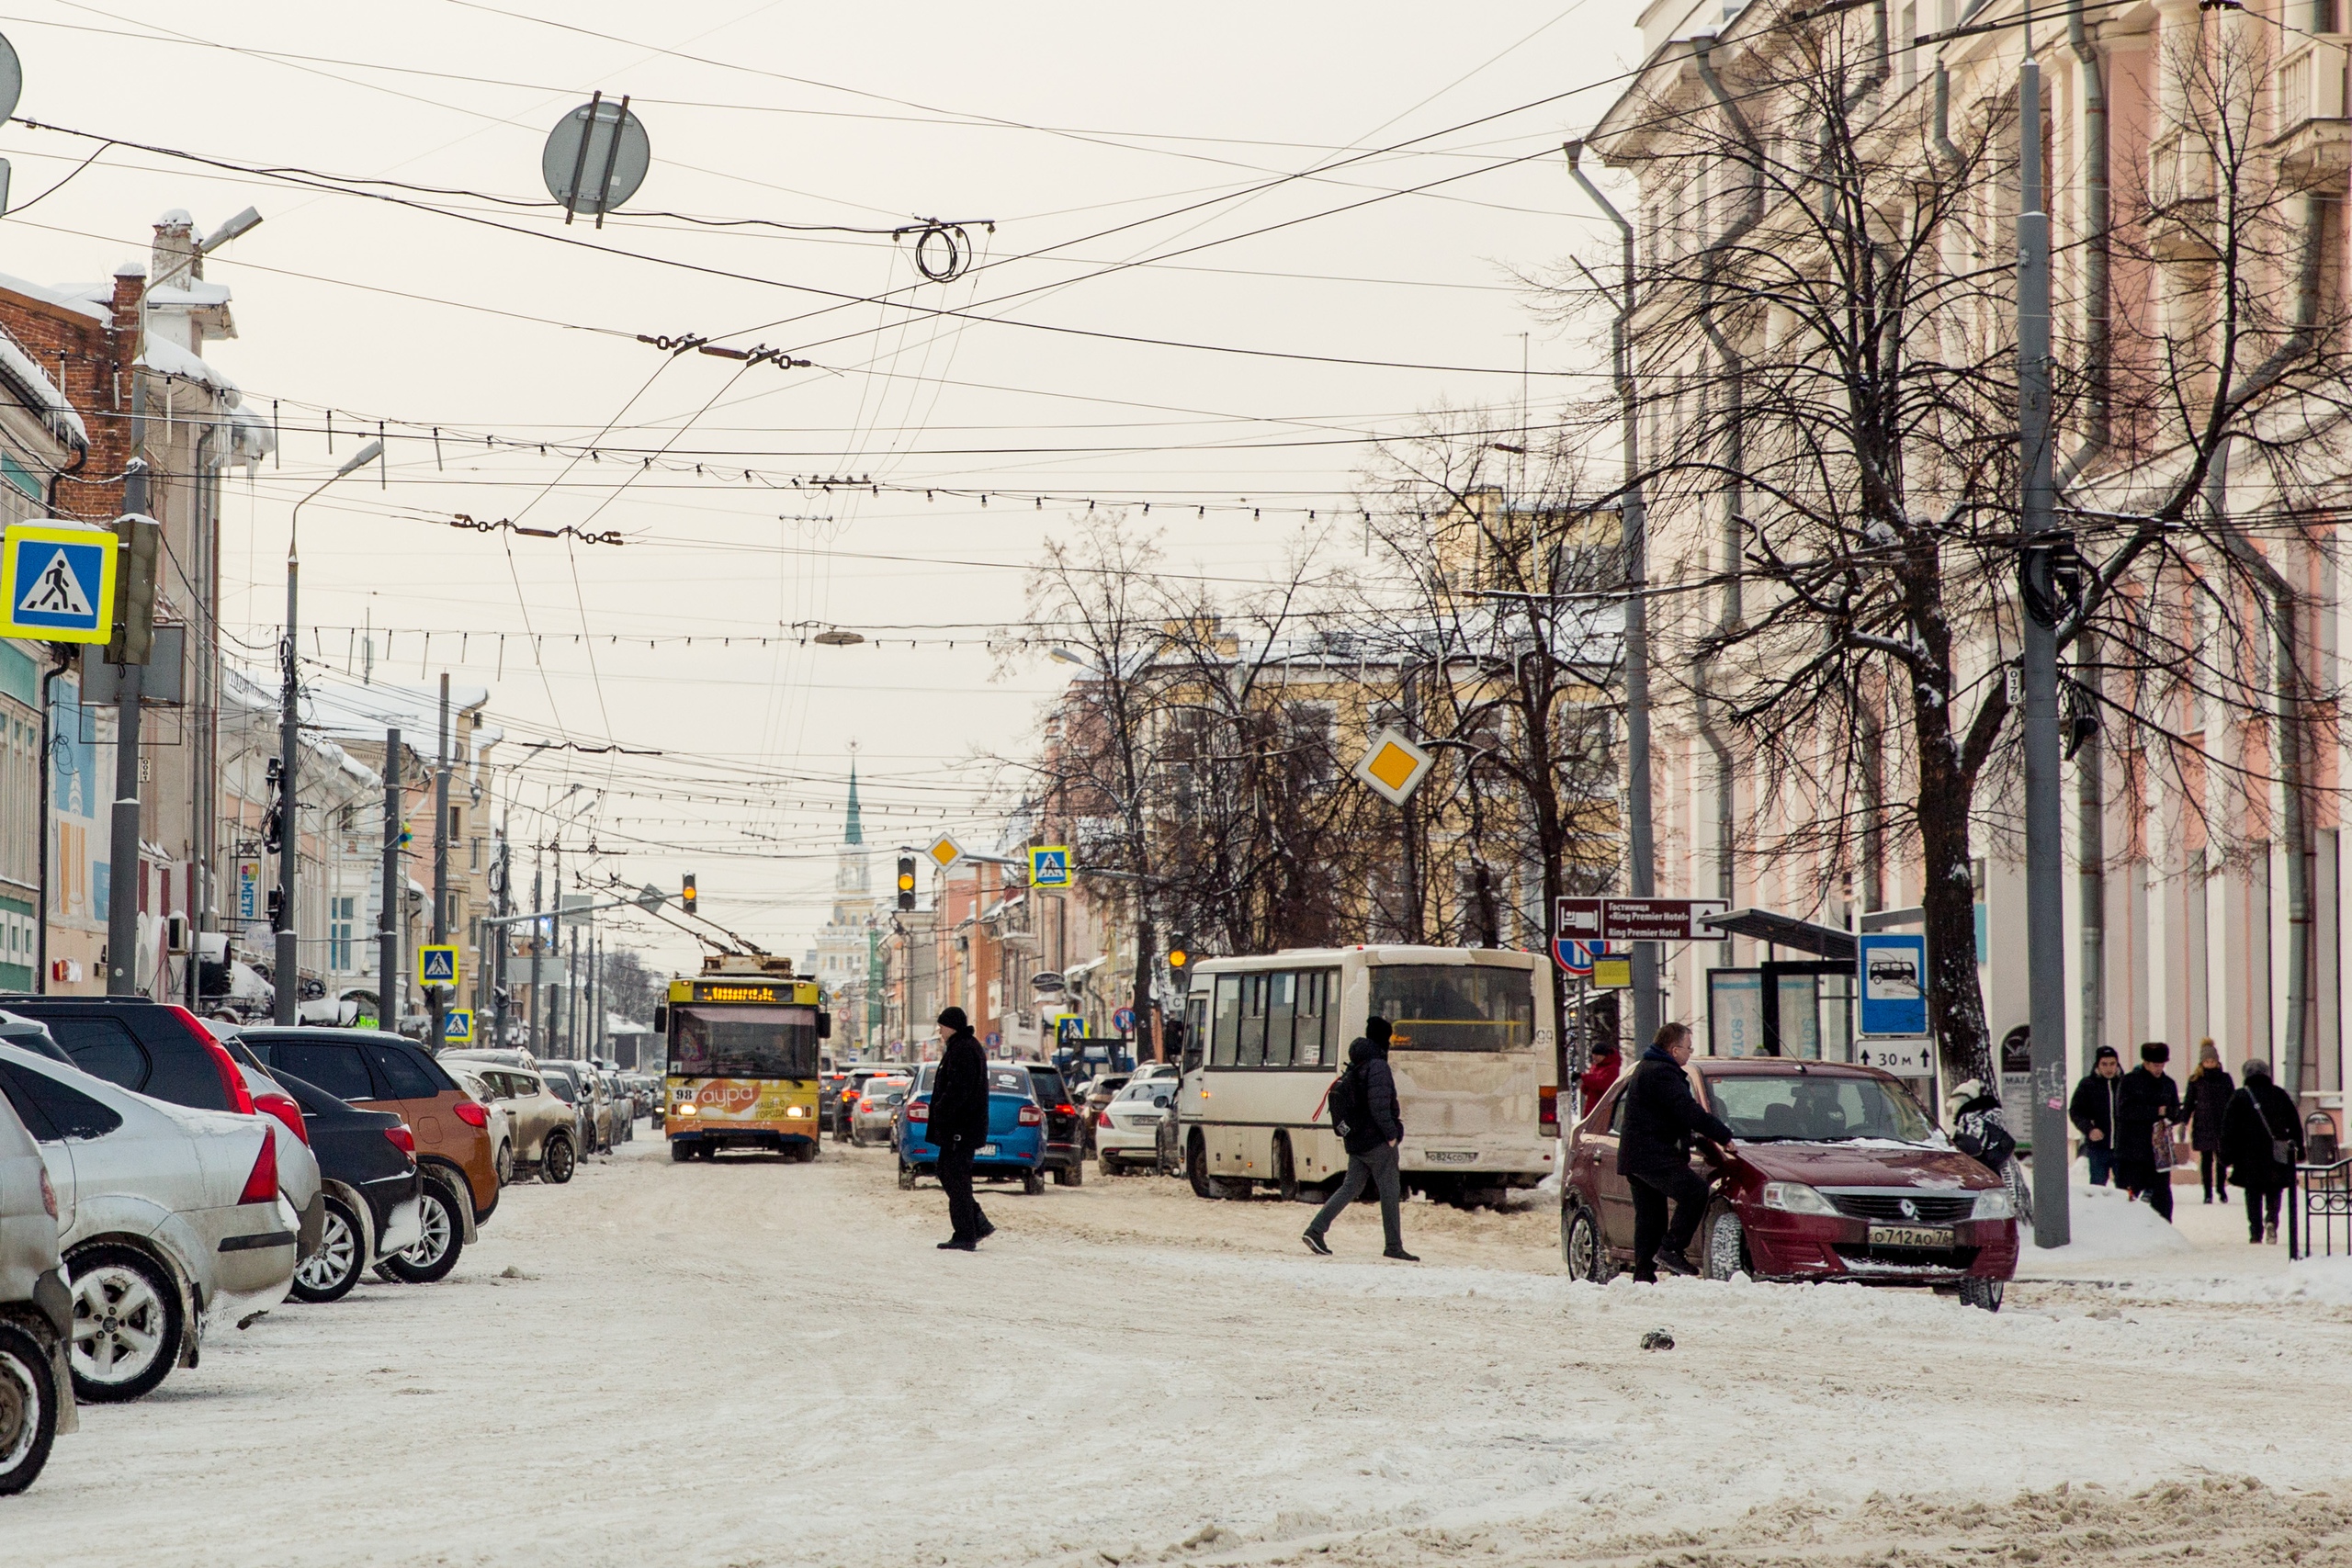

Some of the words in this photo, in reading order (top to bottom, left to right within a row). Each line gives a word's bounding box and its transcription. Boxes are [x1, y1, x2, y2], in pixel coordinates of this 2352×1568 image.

[2010, 671, 2018, 702] 0176
[242, 882, 254, 917] МЕТР
[1609, 902, 1650, 912] Гостиница
[1632, 911, 1663, 921] Premier
[1608, 928, 1626, 938] Ring
[1627, 928, 1658, 937] Premier
[1658, 928, 1680, 937] Hotel
[1879, 1053, 1897, 1066] 30
[676, 1089, 693, 1100] 98
[701, 1087, 753, 1108] аура
[755, 1110, 786, 1119] ГОРОДА
